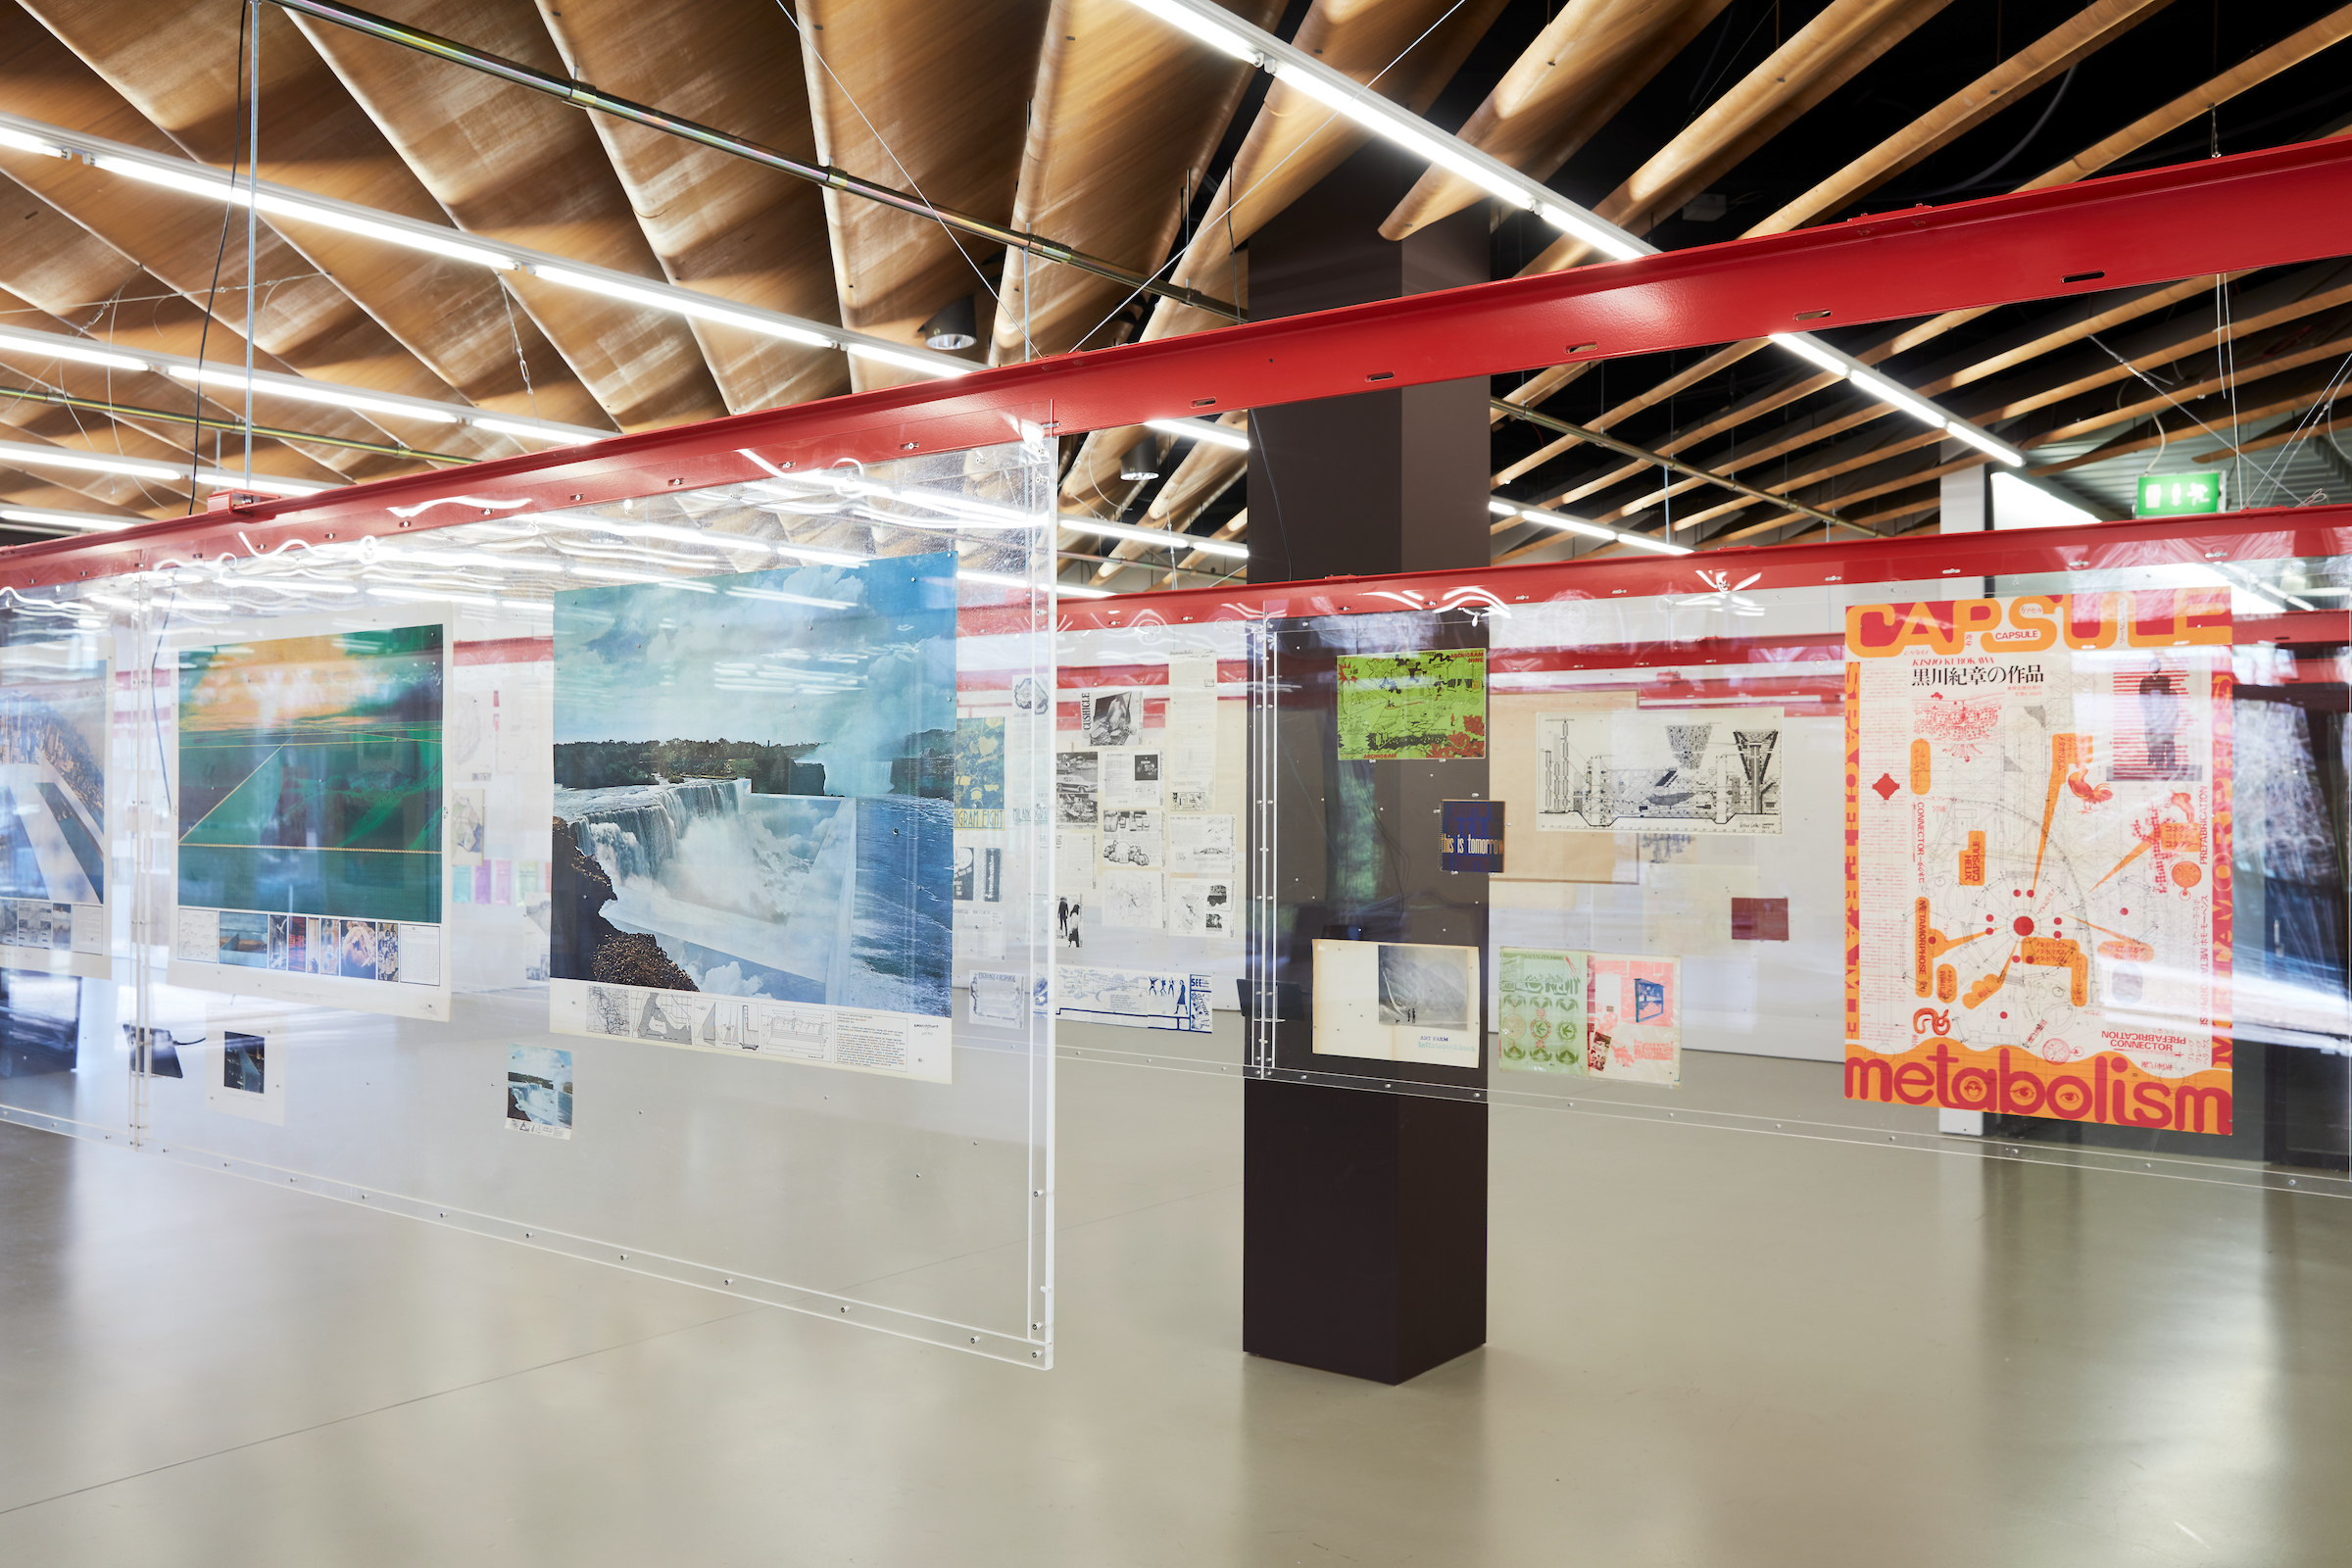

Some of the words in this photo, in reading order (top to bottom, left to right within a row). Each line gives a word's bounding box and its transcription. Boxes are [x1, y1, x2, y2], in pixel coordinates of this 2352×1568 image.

[1845, 586, 2232, 658] CAPSULE
[1995, 629, 2038, 640] CAPSULE
[1912, 658, 1942, 666] KISHO
[1944, 656, 1994, 665] KUROKAWA
[1912, 664, 2044, 686] 黒川紀章の作品
[1081, 692, 1092, 730] CUSHICLE
[982, 809, 1004, 827] EIGHT
[1442, 833, 1454, 854] this
[1457, 834, 1464, 854] is
[1468, 834, 1504, 855] tomorrow
[1972, 841, 1981, 882] CAPSULE
[1918, 900, 1927, 975] METAMORPHOSE
[2101, 1030, 2186, 1045] PREFABRICATION
[2110, 1039, 2173, 1052] CONNECTOR
[1845, 1044, 2232, 1134] metabolism
